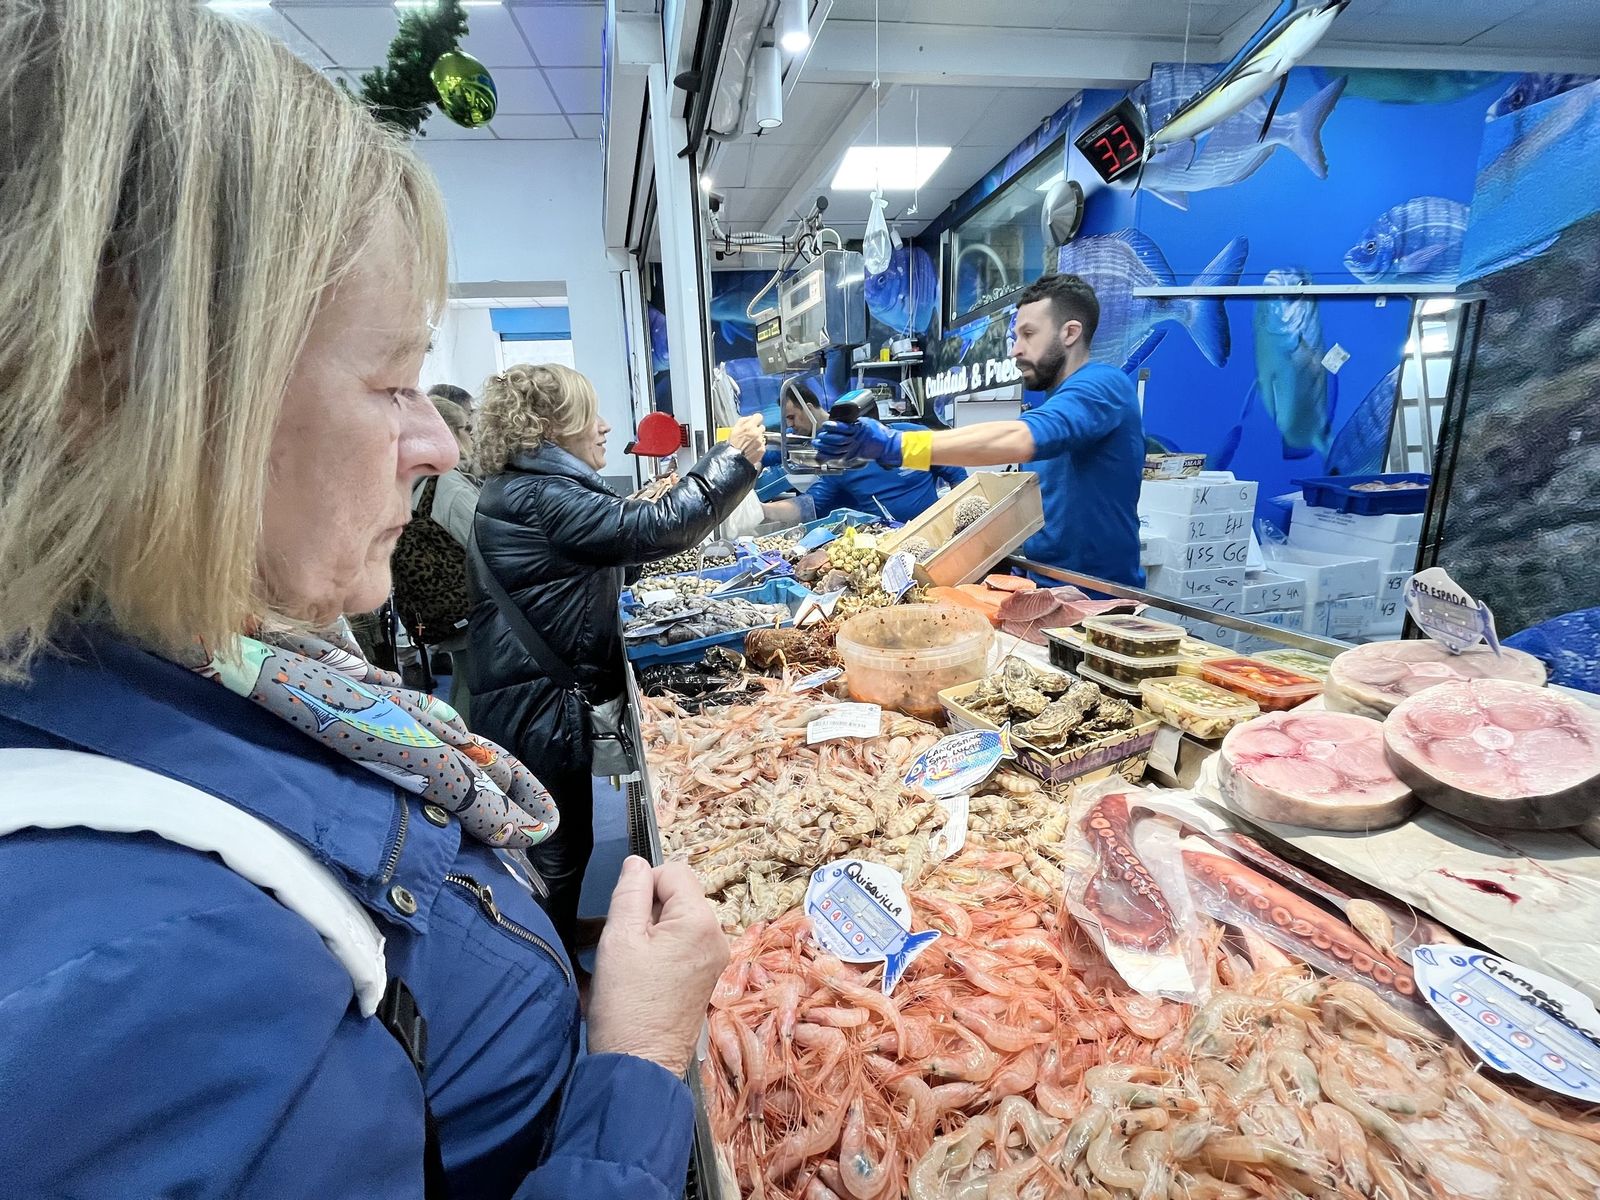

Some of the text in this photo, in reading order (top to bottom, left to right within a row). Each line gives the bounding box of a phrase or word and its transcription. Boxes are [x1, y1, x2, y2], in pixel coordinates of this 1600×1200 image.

[1093, 124, 1138, 173] 33
[925, 357, 1023, 400] Calidad & Fres
[1380, 601, 1397, 617] 43
[1431, 586, 1468, 608] ESPADA
